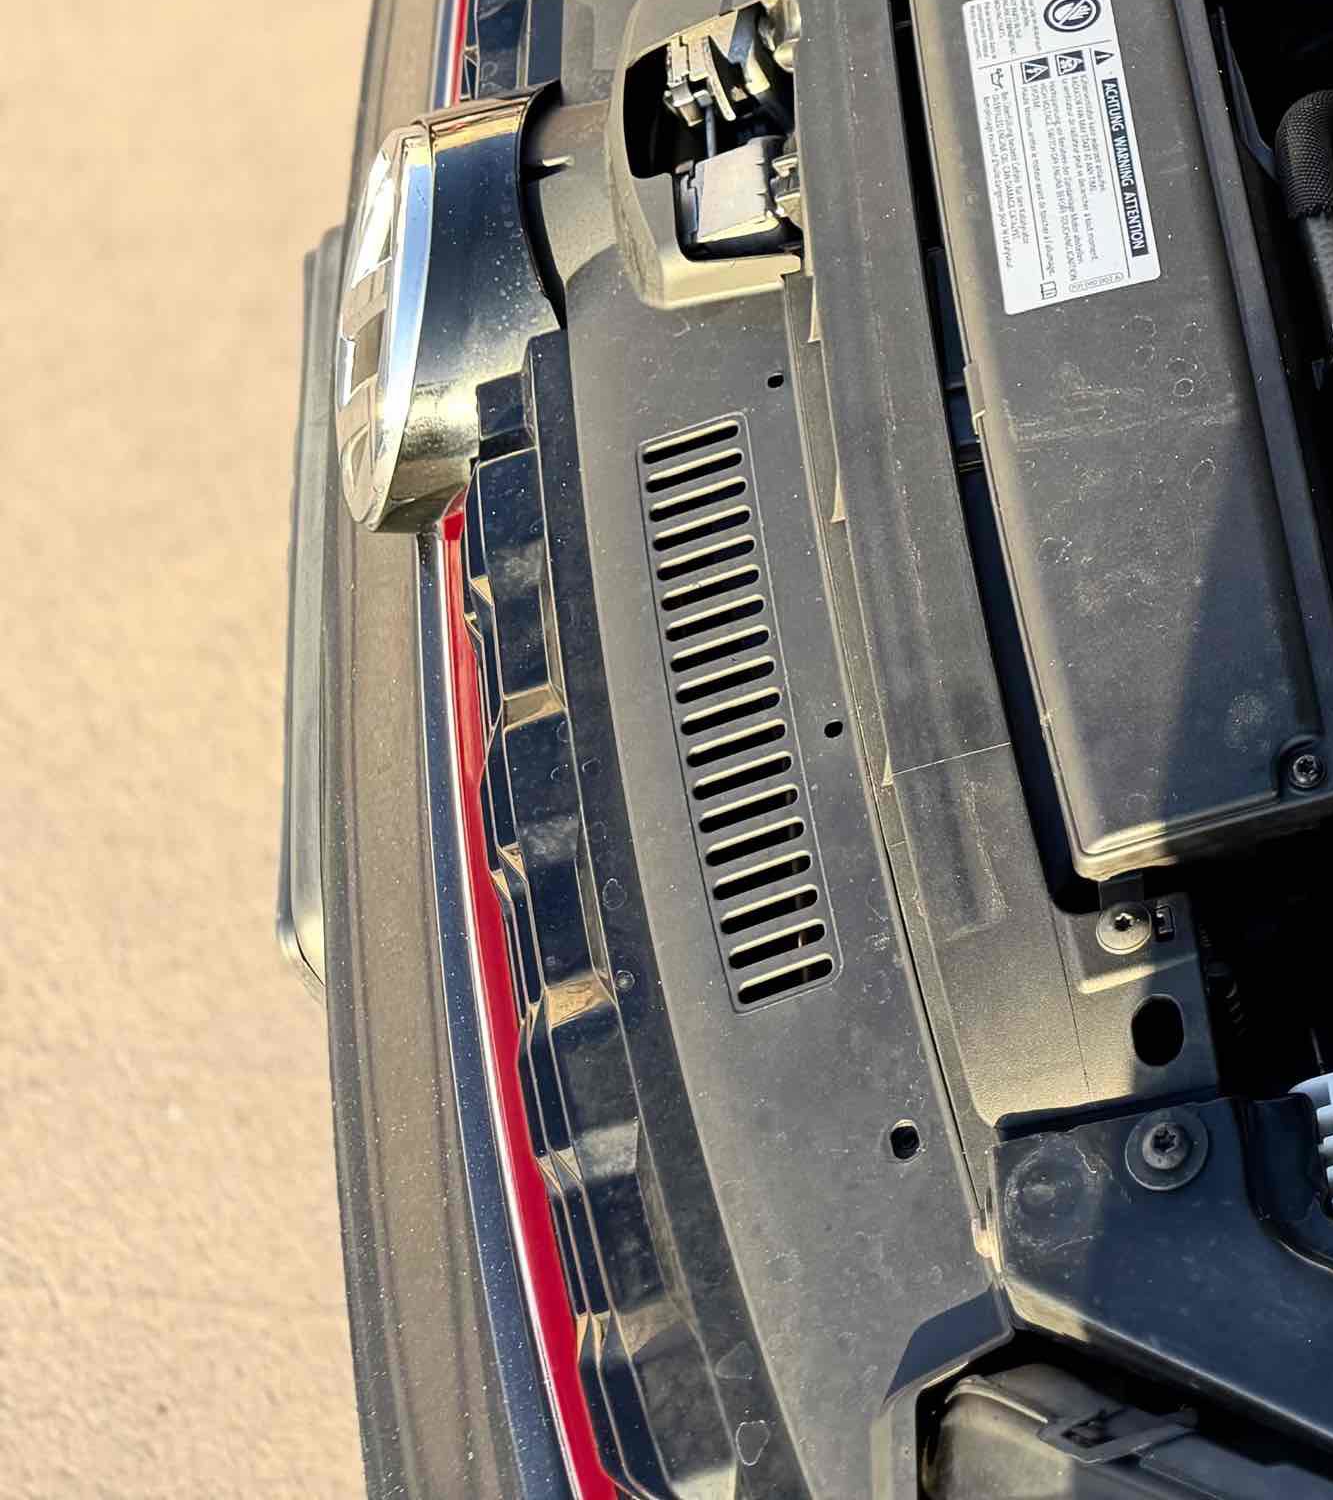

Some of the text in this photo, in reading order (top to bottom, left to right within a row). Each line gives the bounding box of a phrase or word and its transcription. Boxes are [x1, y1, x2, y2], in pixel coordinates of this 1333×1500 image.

[1102, 82, 1146, 248] ACHTUNG WARNING ATTENTION
